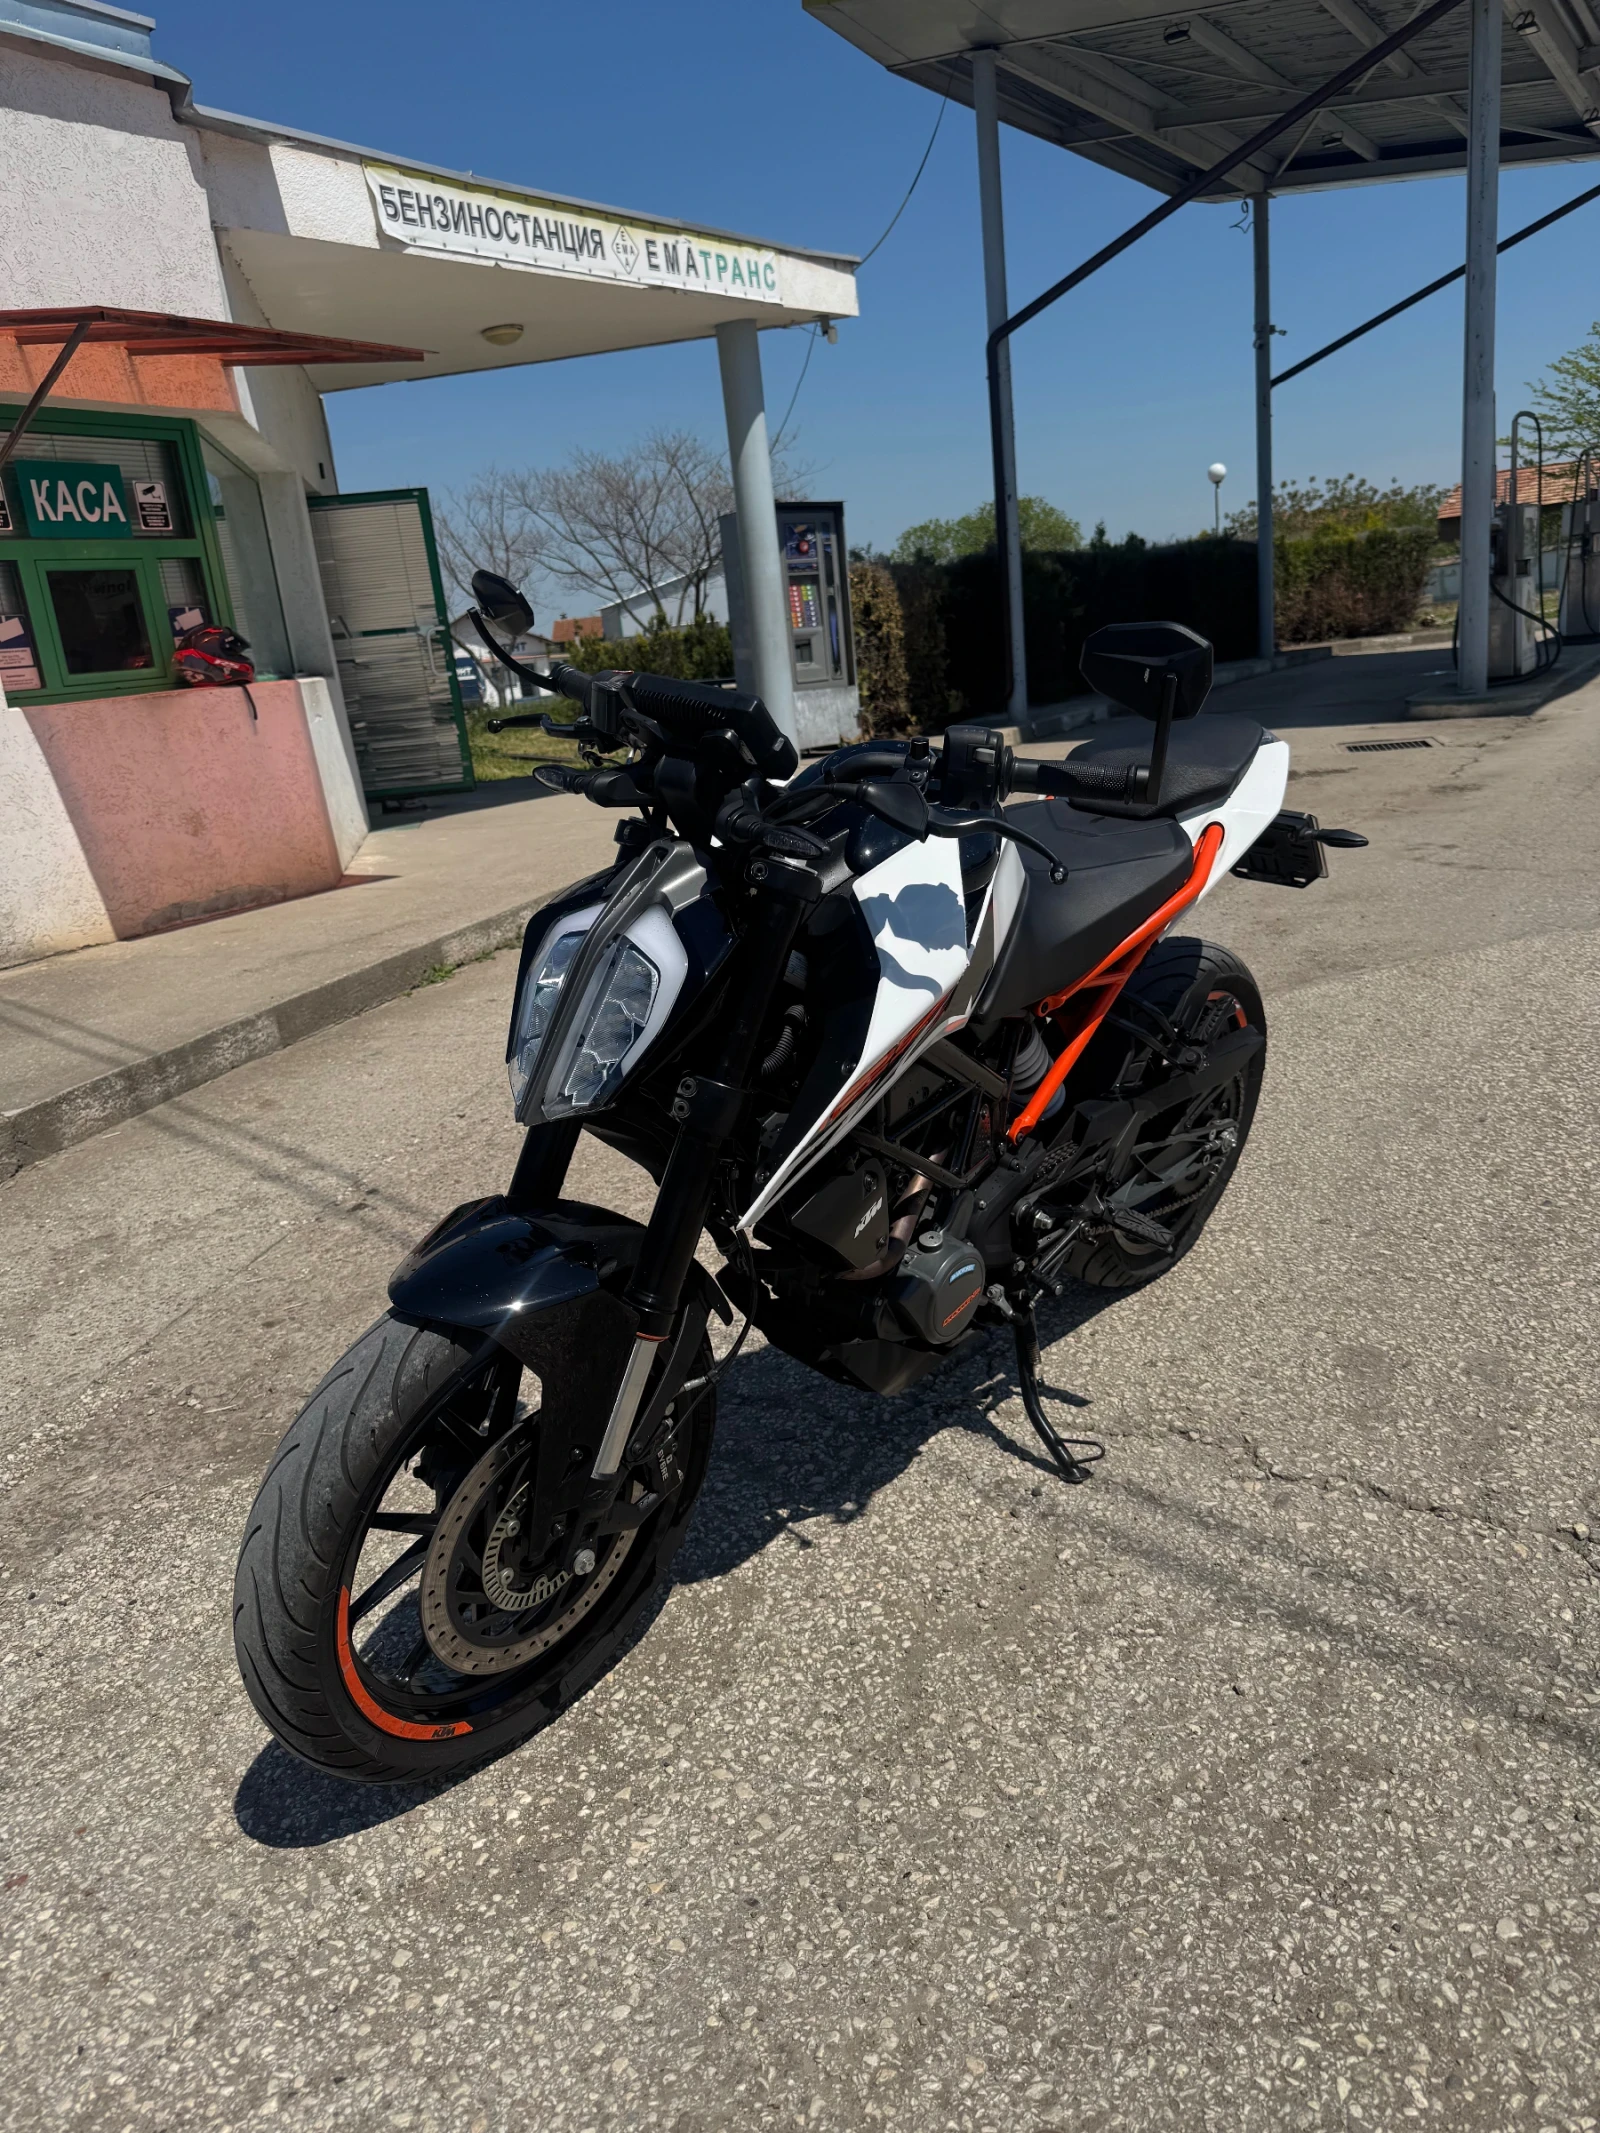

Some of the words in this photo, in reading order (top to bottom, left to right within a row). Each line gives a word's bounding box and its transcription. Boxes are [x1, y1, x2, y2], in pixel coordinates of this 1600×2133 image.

[379, 185, 606, 261] БЕНЗИНОСТАНЦИЯ
[30, 479, 126, 522] КАСА
[854, 1196, 882, 1239] KTM
[431, 1726, 456, 1738] KTM
